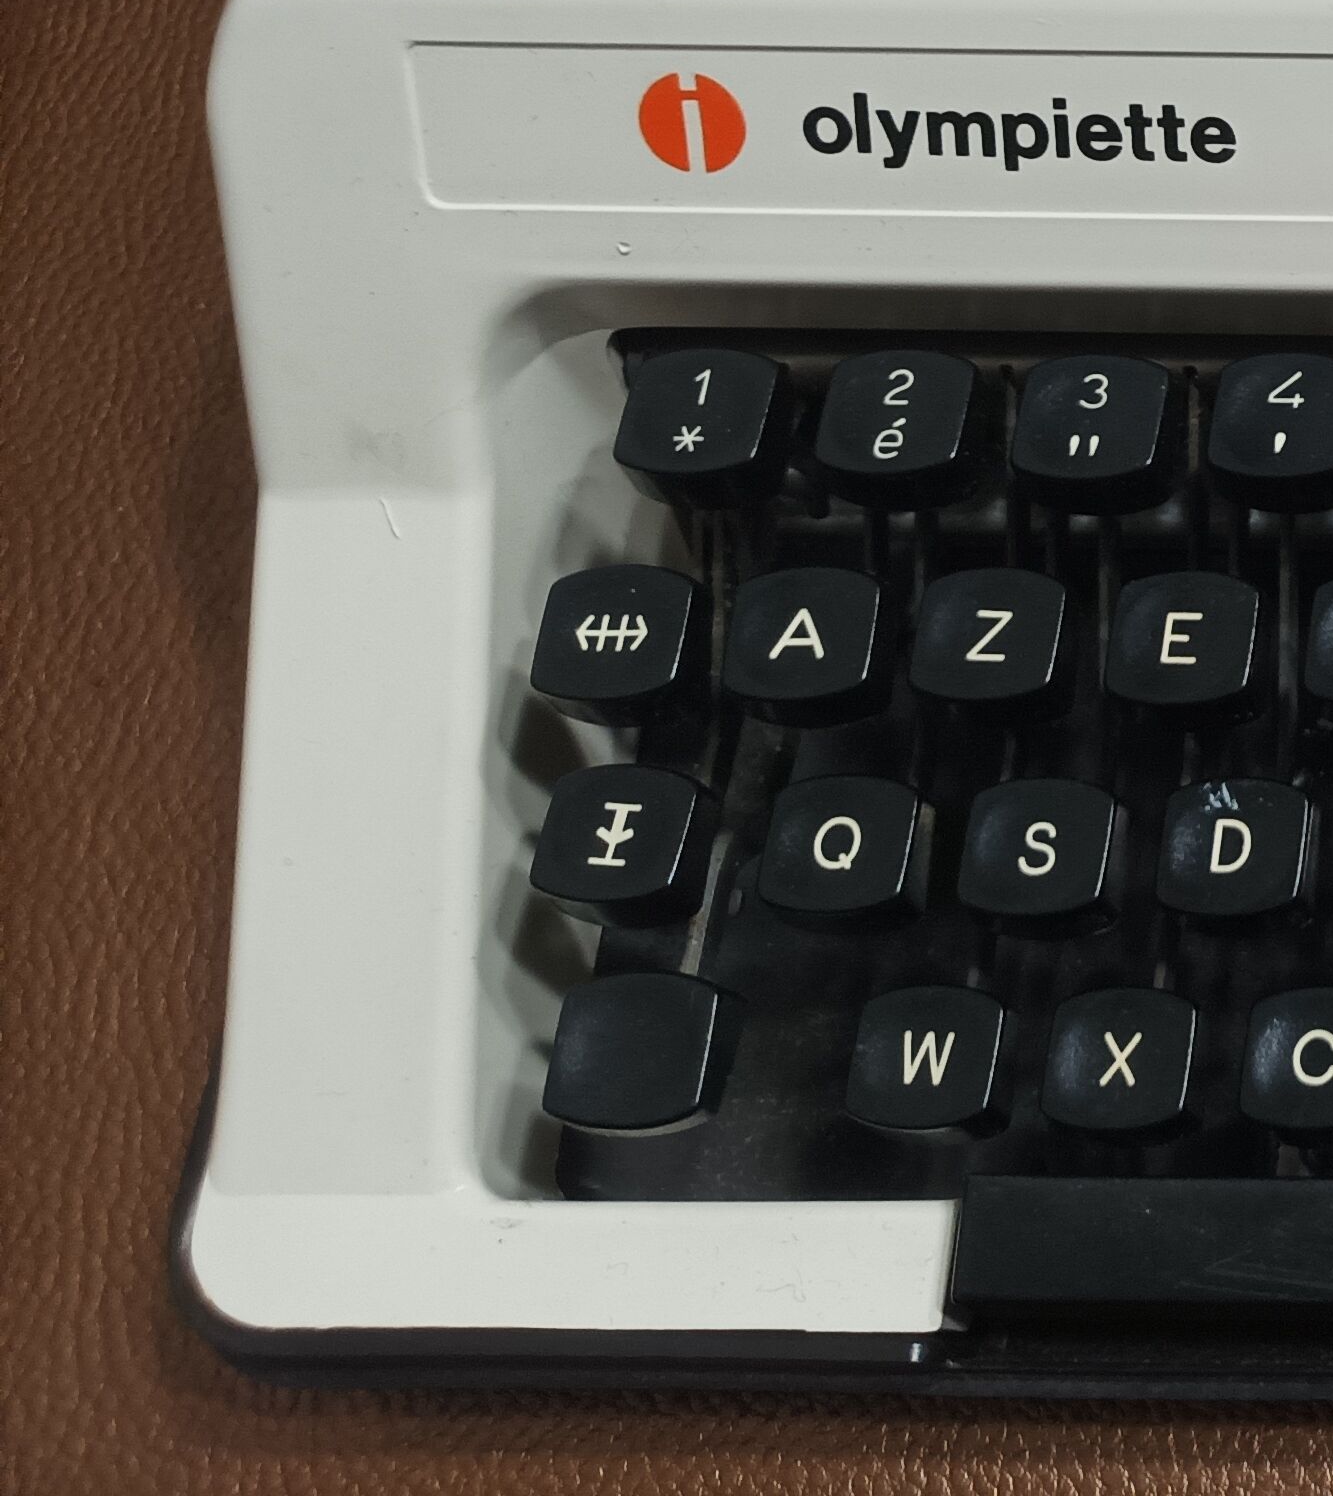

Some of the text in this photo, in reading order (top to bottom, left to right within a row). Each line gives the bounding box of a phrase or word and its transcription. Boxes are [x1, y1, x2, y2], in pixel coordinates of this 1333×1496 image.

[802, 91, 1237, 172] olympiette
[693, 368, 713, 406] 1
[883, 369, 915, 406] 2
[1077, 373, 1109, 409] 3
[1267, 370, 1305, 409] 4
[872, 417, 907, 459] é
[768, 607, 825, 660] A
[965, 609, 1014, 662] Z
[1159, 611, 1204, 665] E
[812, 815, 863, 871] Q
[1016, 820, 1058, 877] S
[1208, 817, 1253, 874] D
[902, 1029, 956, 1087] W
[1098, 1031, 1143, 1088] X
